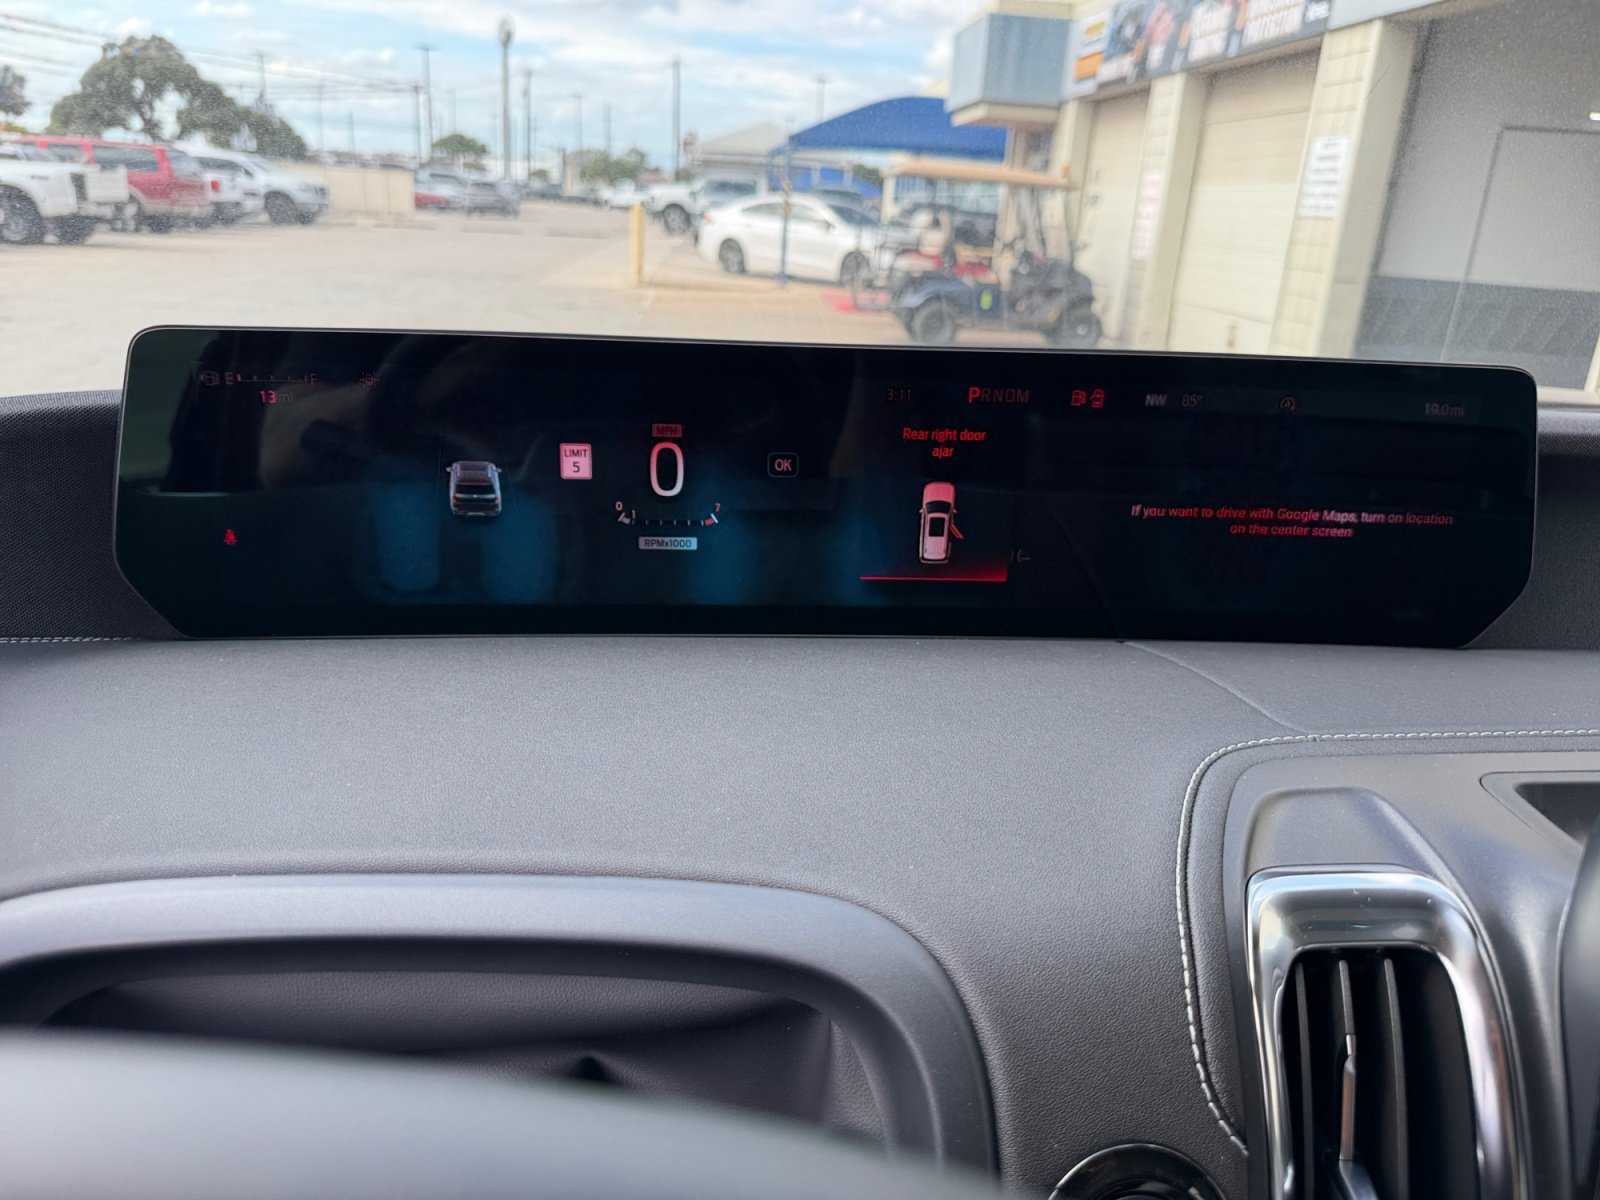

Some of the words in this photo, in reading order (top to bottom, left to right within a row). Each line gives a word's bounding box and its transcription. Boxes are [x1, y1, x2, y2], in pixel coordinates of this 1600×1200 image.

[1145, 393, 1167, 406] NW
[656, 425, 678, 436] MPH
[902, 427, 928, 441] Rear
[931, 428, 957, 444] right
[960, 429, 986, 441] door
[563, 449, 588, 458] LIMIT
[932, 445, 954, 459] ajar
[572, 461, 581, 473] 5
[649, 441, 685, 497] 0
[774, 458, 792, 472] OK
[1131, 503, 1142, 516] If
[1143, 506, 1166, 519] you
[1168, 507, 1199, 517] want
[1201, 506, 1213, 518] to
[1216, 506, 1246, 519] drive
[1249, 507, 1274, 519] with
[1277, 508, 1319, 522] Google
[1361, 511, 1385, 523] turn
[1388, 513, 1402, 523] on
[1405, 511, 1453, 525] location
[1230, 525, 1245, 535] on
[1249, 523, 1268, 535] the
[1270, 525, 1309, 536] center
[1312, 527, 1353, 537] screen
